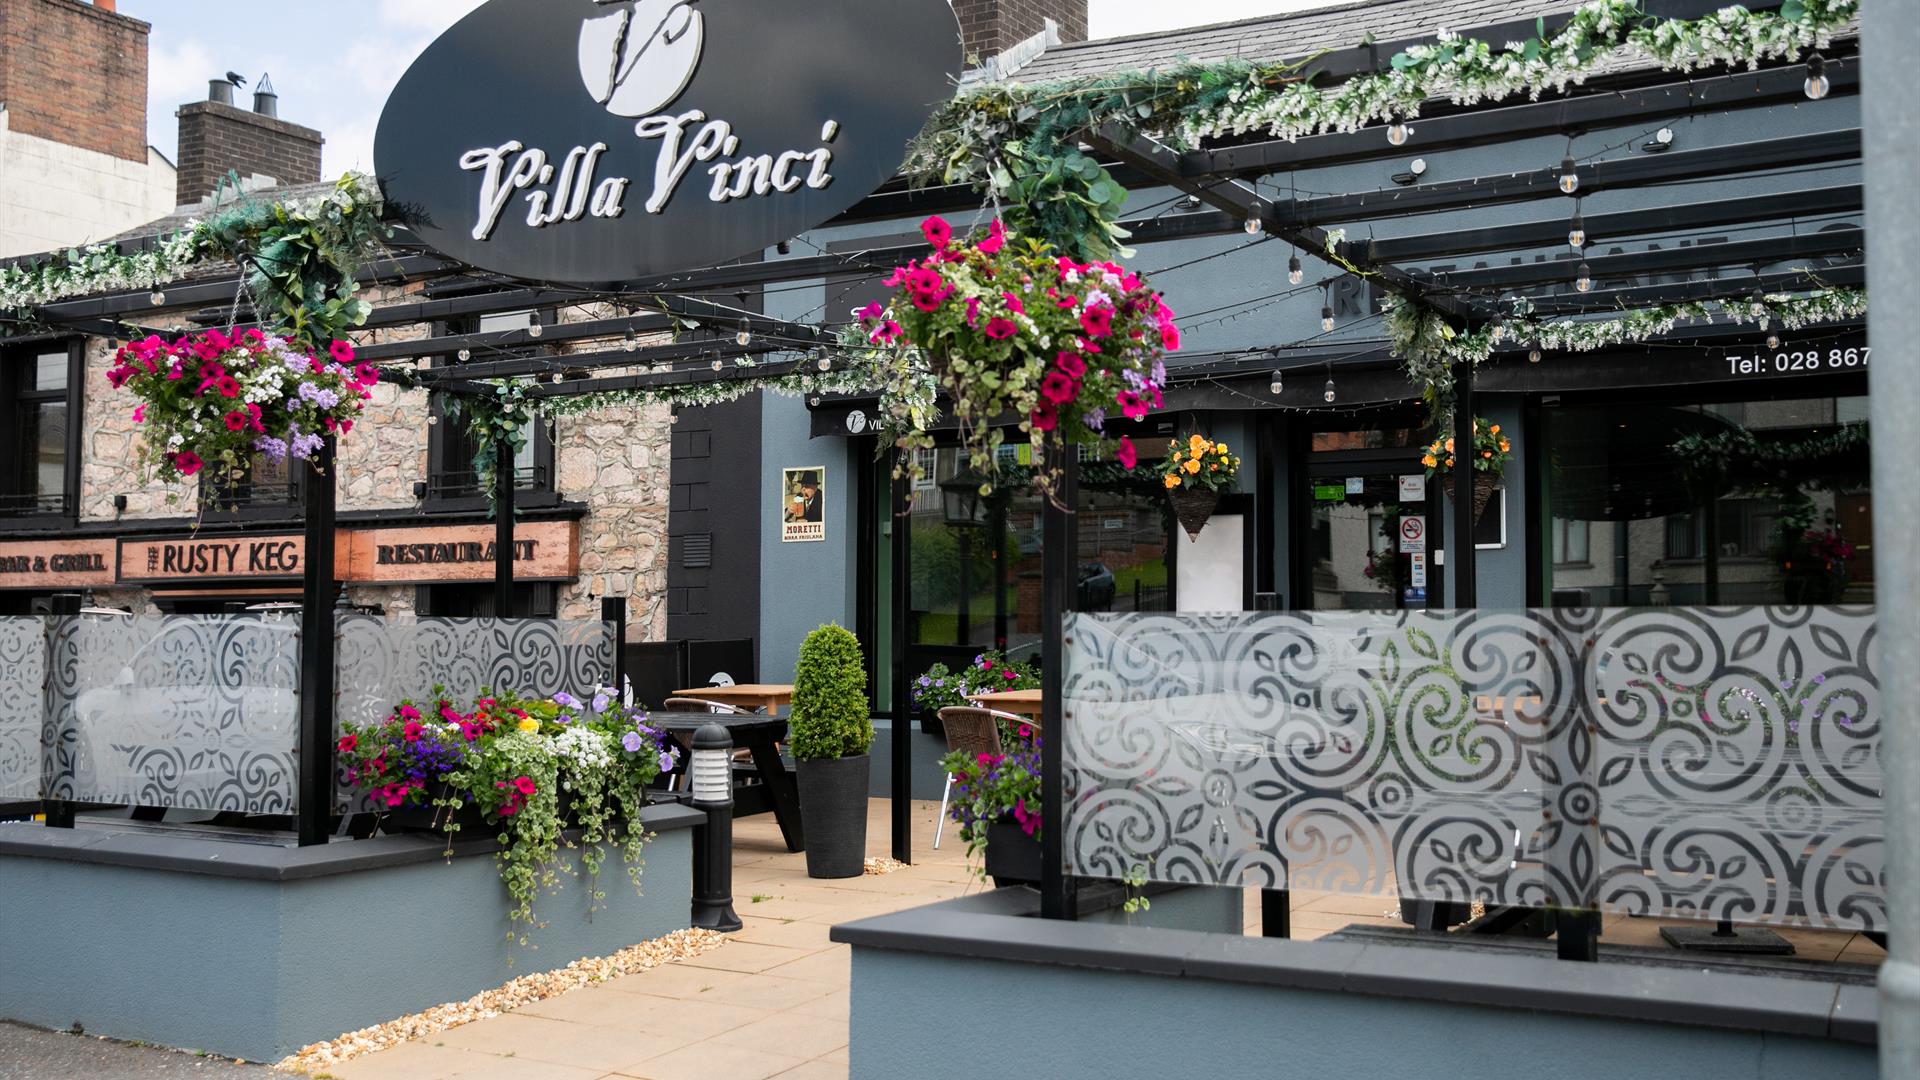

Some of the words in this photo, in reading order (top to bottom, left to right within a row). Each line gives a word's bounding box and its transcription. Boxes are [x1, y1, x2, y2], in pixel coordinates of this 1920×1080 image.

[459, 140, 630, 240] Villa
[635, 109, 839, 214] Vinci
[1726, 355, 1766, 374] Tel:
[1775, 351, 1819, 371] 028
[786, 525, 821, 534] MORETTI
[32, 556, 48, 572] &
[50, 553, 108, 572] GRILL
[163, 543, 241, 573] RUSTY
[249, 541, 298, 571] KEG
